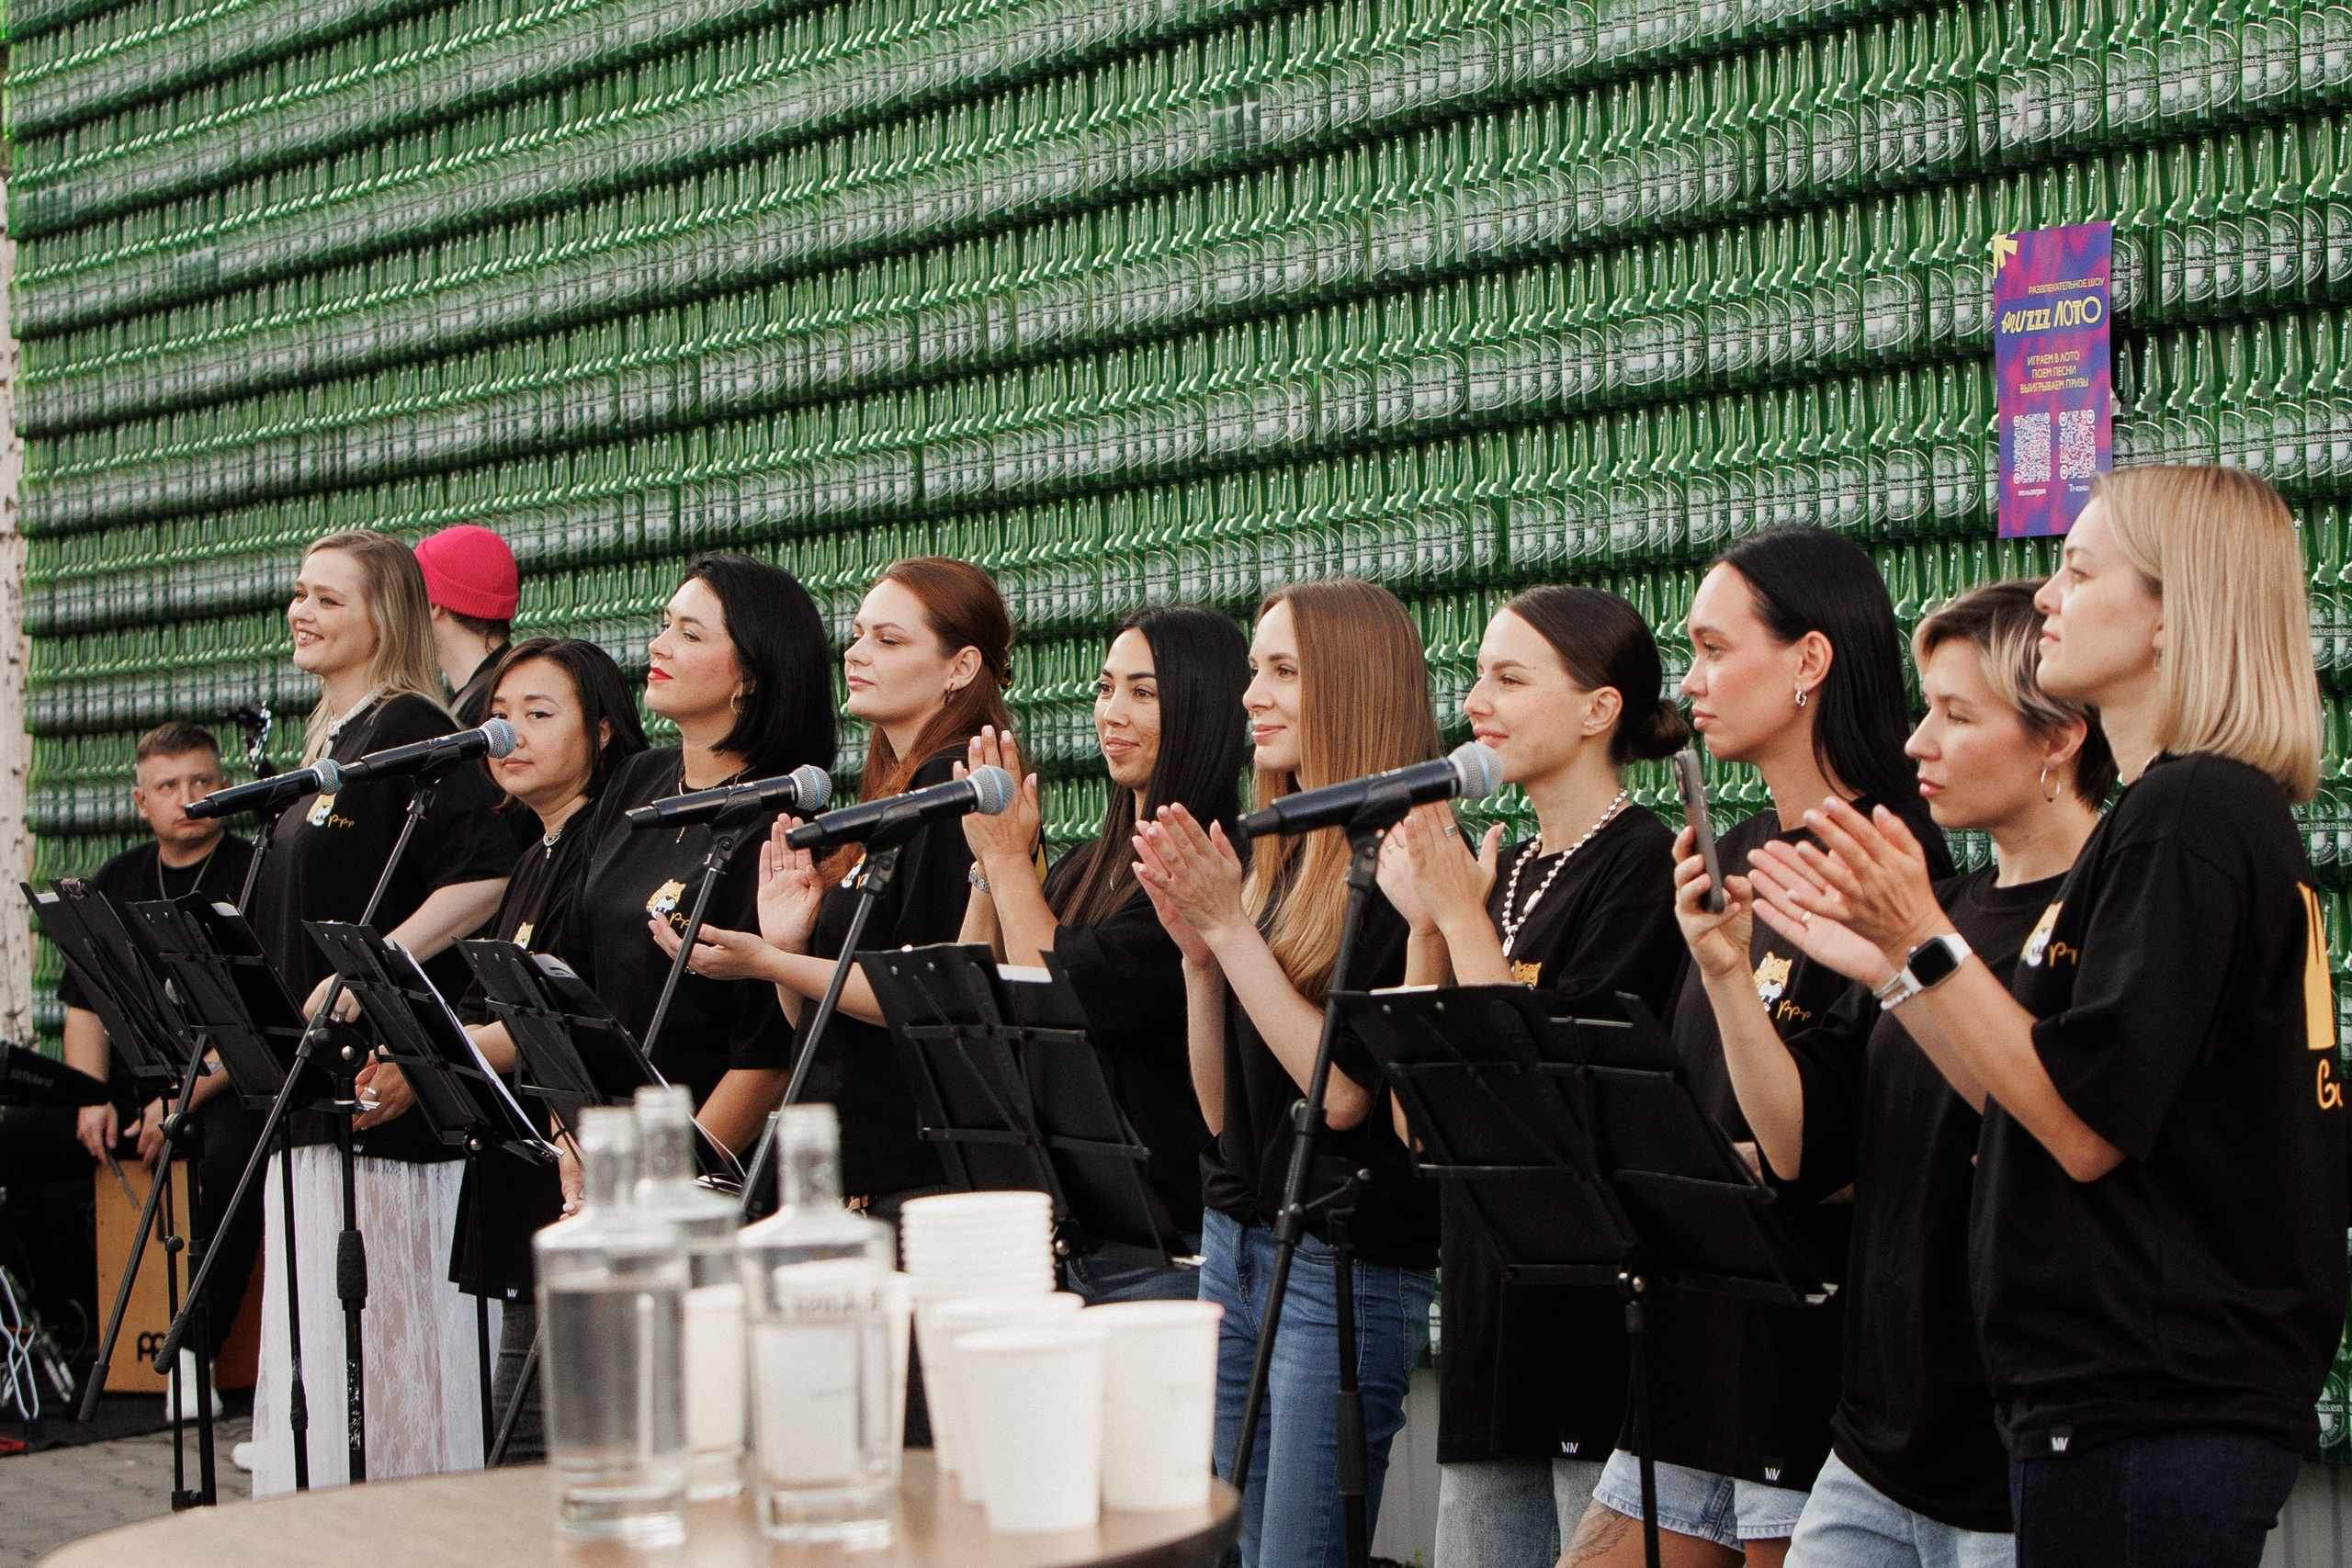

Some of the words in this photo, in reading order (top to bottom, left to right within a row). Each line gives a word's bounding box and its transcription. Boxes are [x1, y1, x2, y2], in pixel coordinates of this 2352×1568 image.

[2028, 279, 2087, 295] РАЗВЛЕКАТЕЛЬНОЕ
[2087, 276, 2105, 288] ШОУ
[2053, 296, 2102, 328] ЛОТО
[2027, 355, 2054, 366] ИГРАЕМ
[2055, 355, 2059, 363] В
[2060, 351, 2080, 362] ЛОТО
[2031, 367, 2052, 378] ПОЕМ
[2053, 365, 2076, 376] ПЕСНИ
[2019, 379, 2064, 394] ВЫИГРЫВАЕМ
[2065, 378, 2089, 389] ПРИЗЫ
